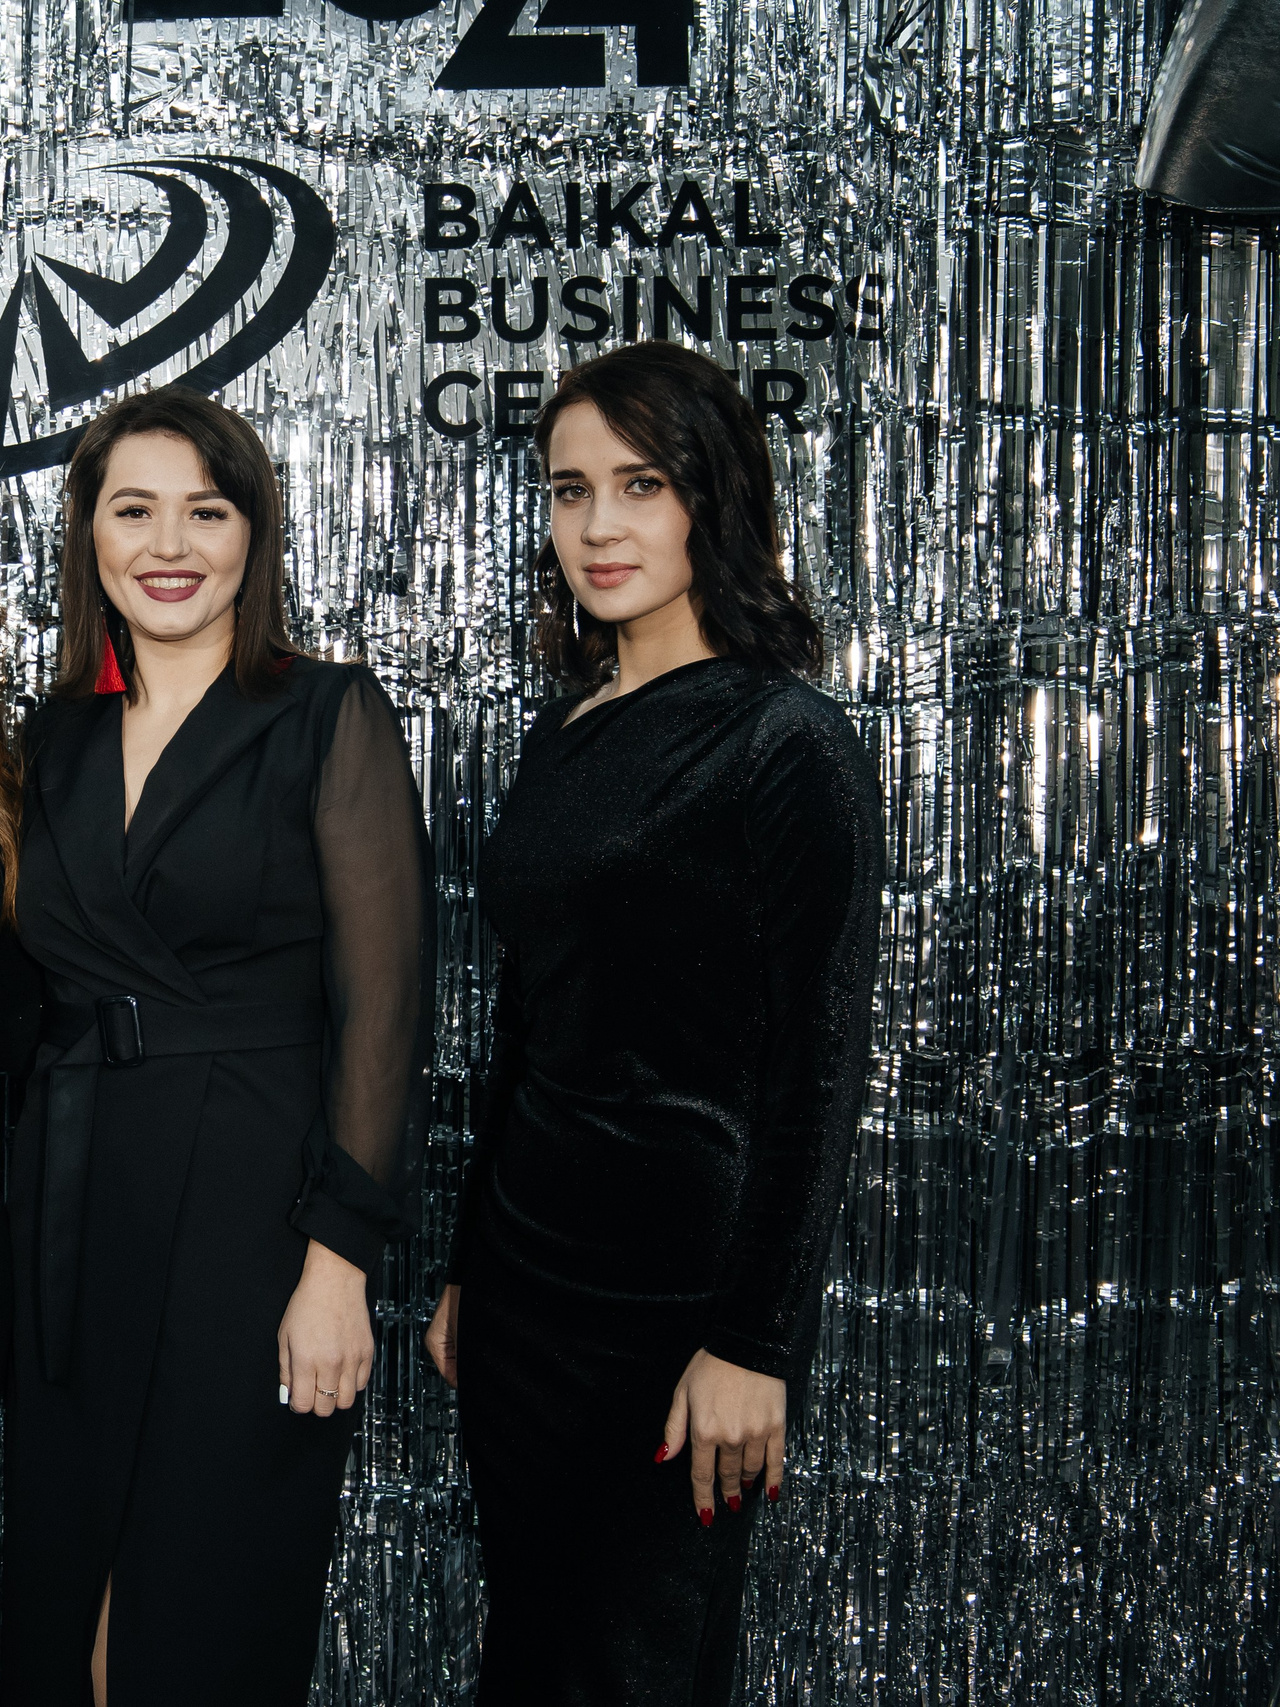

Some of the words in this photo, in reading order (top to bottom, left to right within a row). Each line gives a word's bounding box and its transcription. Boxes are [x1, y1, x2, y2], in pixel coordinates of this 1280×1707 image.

[424, 180, 783, 251] BAIKAL
[424, 273, 886, 345] BUSINESS
[423, 368, 808, 438] CER
